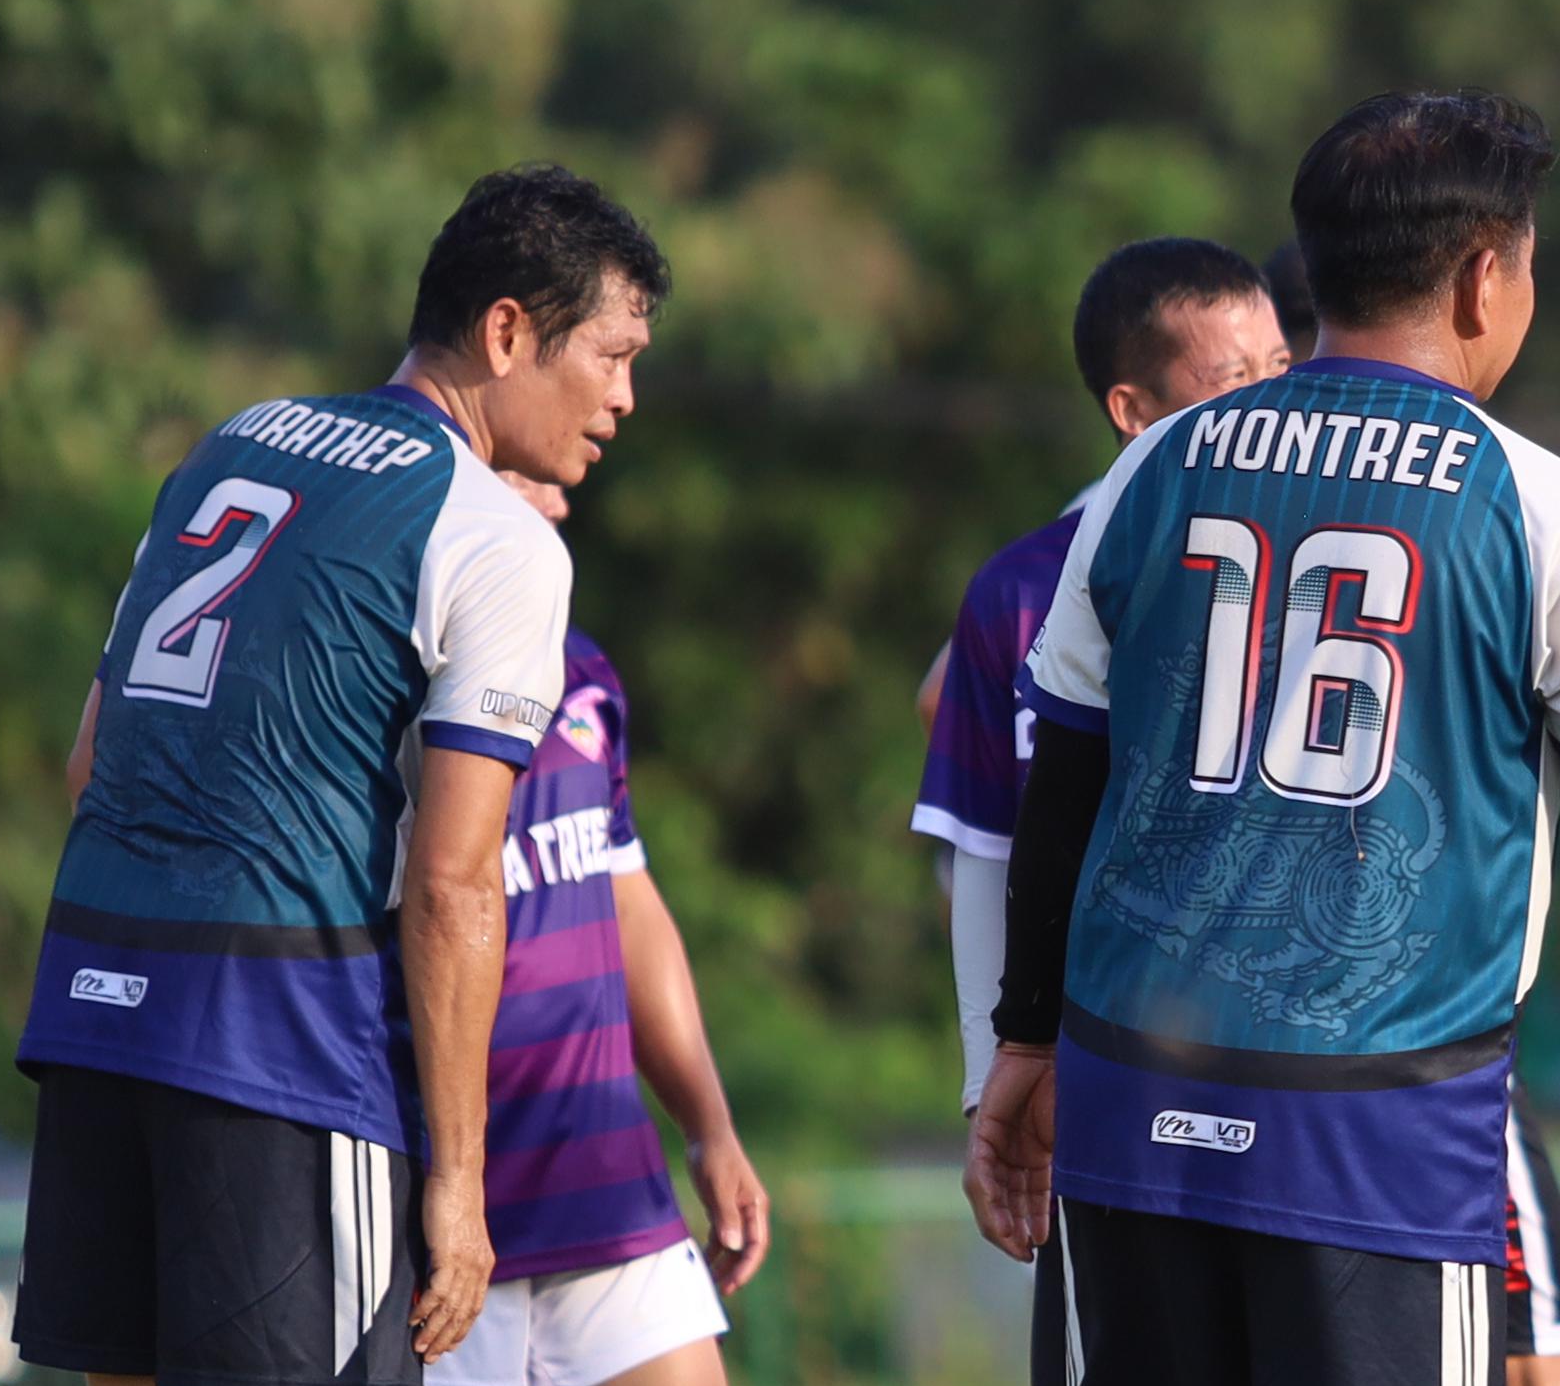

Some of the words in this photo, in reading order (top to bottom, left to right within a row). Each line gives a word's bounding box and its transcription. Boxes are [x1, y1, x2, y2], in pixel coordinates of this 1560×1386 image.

[1183, 407, 1477, 495] MONTREE
[121, 477, 302, 710] 2
[1181, 516, 1425, 808] 16
